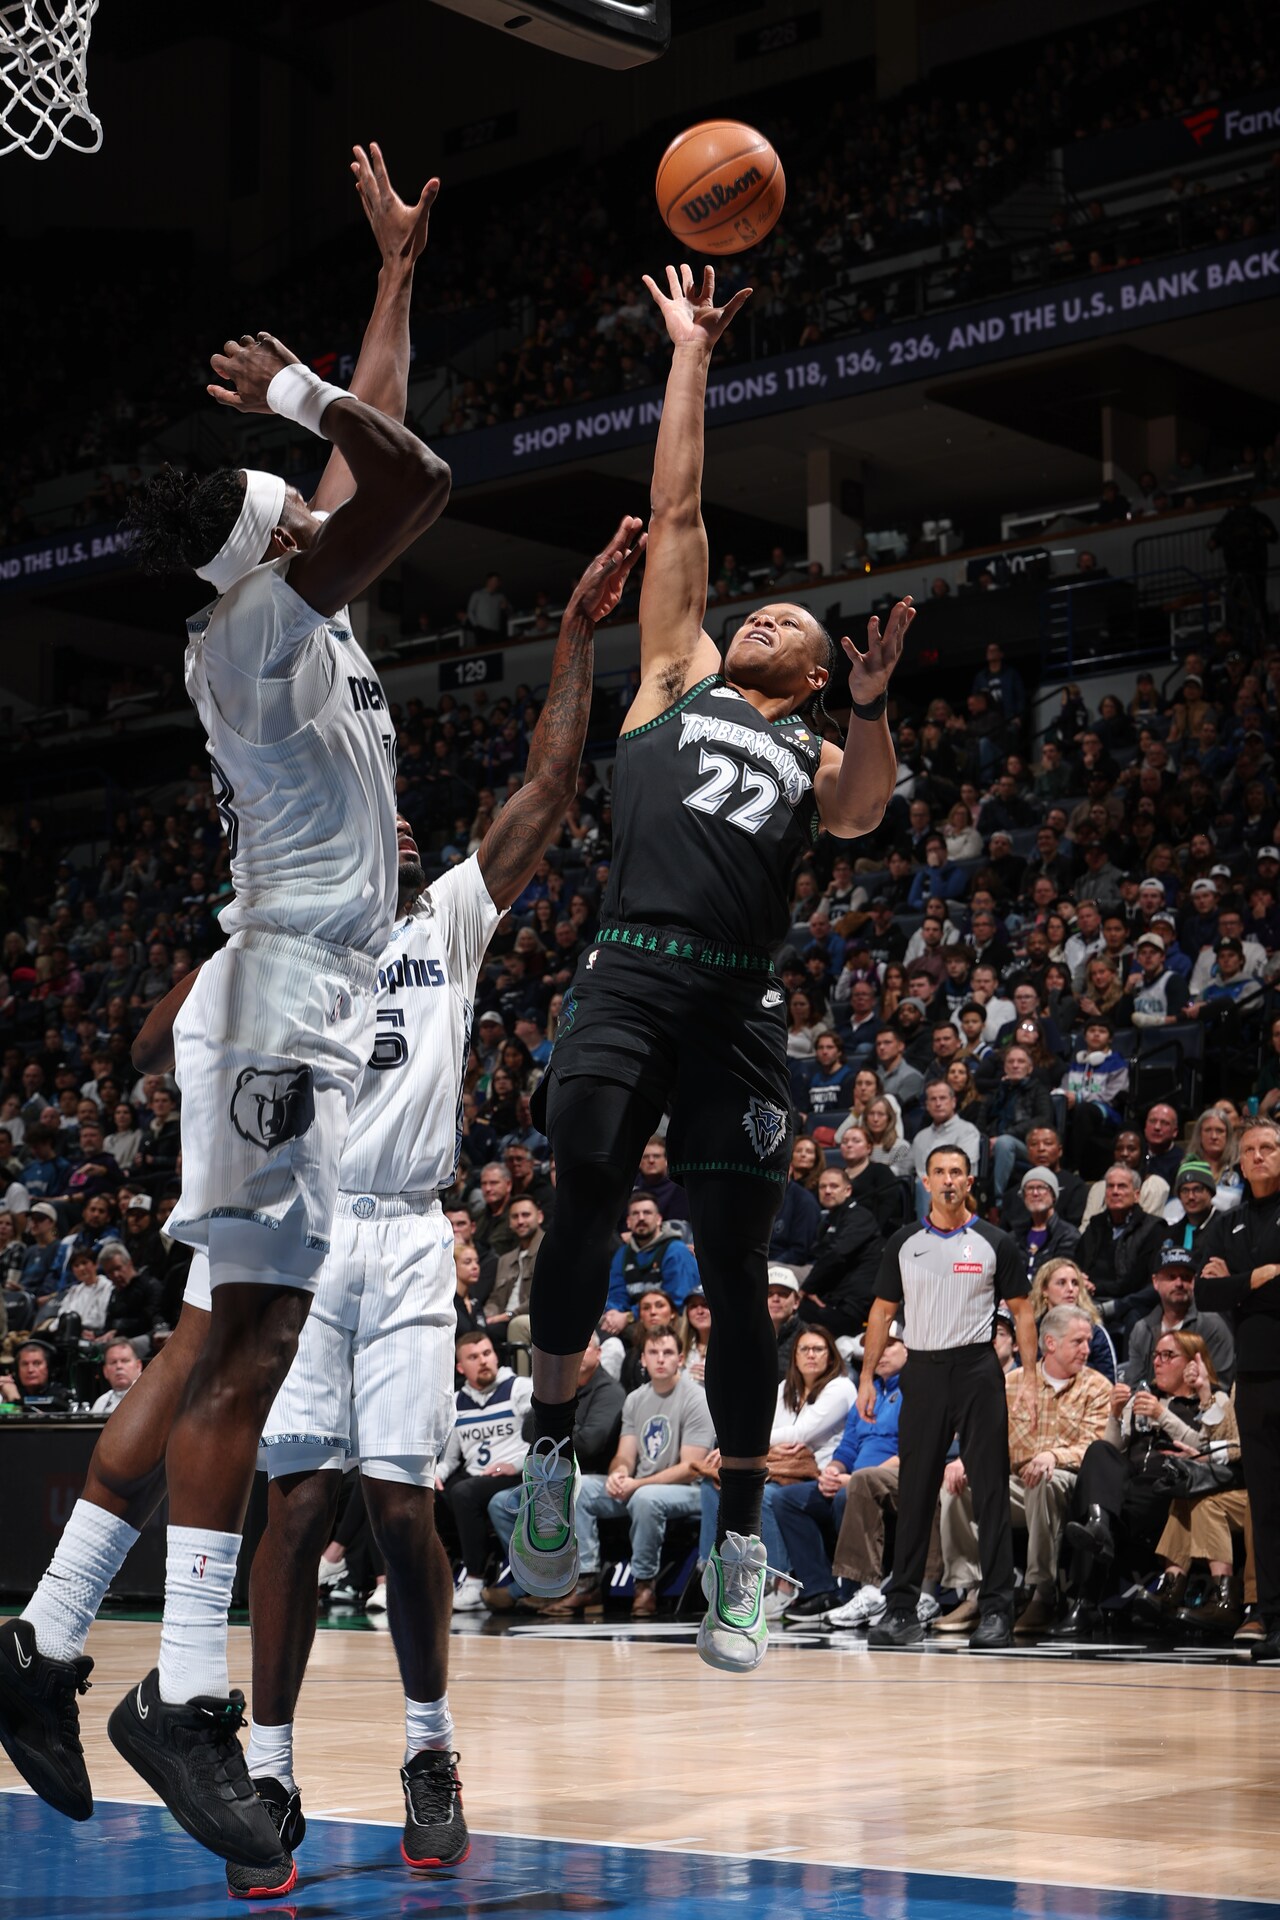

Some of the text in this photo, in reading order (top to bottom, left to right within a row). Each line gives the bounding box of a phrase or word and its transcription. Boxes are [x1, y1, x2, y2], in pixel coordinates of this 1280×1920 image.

[682, 166, 763, 223] Wilson
[512, 422, 572, 456] SHOP
[575, 406, 635, 441] NOW
[638, 399, 665, 425] IN
[703, 371, 778, 411] TIONS
[784, 361, 829, 391] 118,
[835, 348, 884, 378] 136,
[888, 333, 941, 367] 236,
[946, 317, 1006, 352] AND
[1009, 304, 1057, 337] THE
[1062, 291, 1114, 324] U.S.
[1120, 268, 1201, 311] BANK
[0, 558, 21, 580] ND
[23, 550, 53, 574] THE
[55, 540, 89, 567] U.S.
[454, 659, 488, 685] 129
[678, 711, 815, 807] TIMBERWOLVES
[682, 747, 780, 835] 22
[374, 953, 446, 995] phis
[460, 1423, 514, 1441] WOLVES
[477, 1440, 491, 1466] 5
